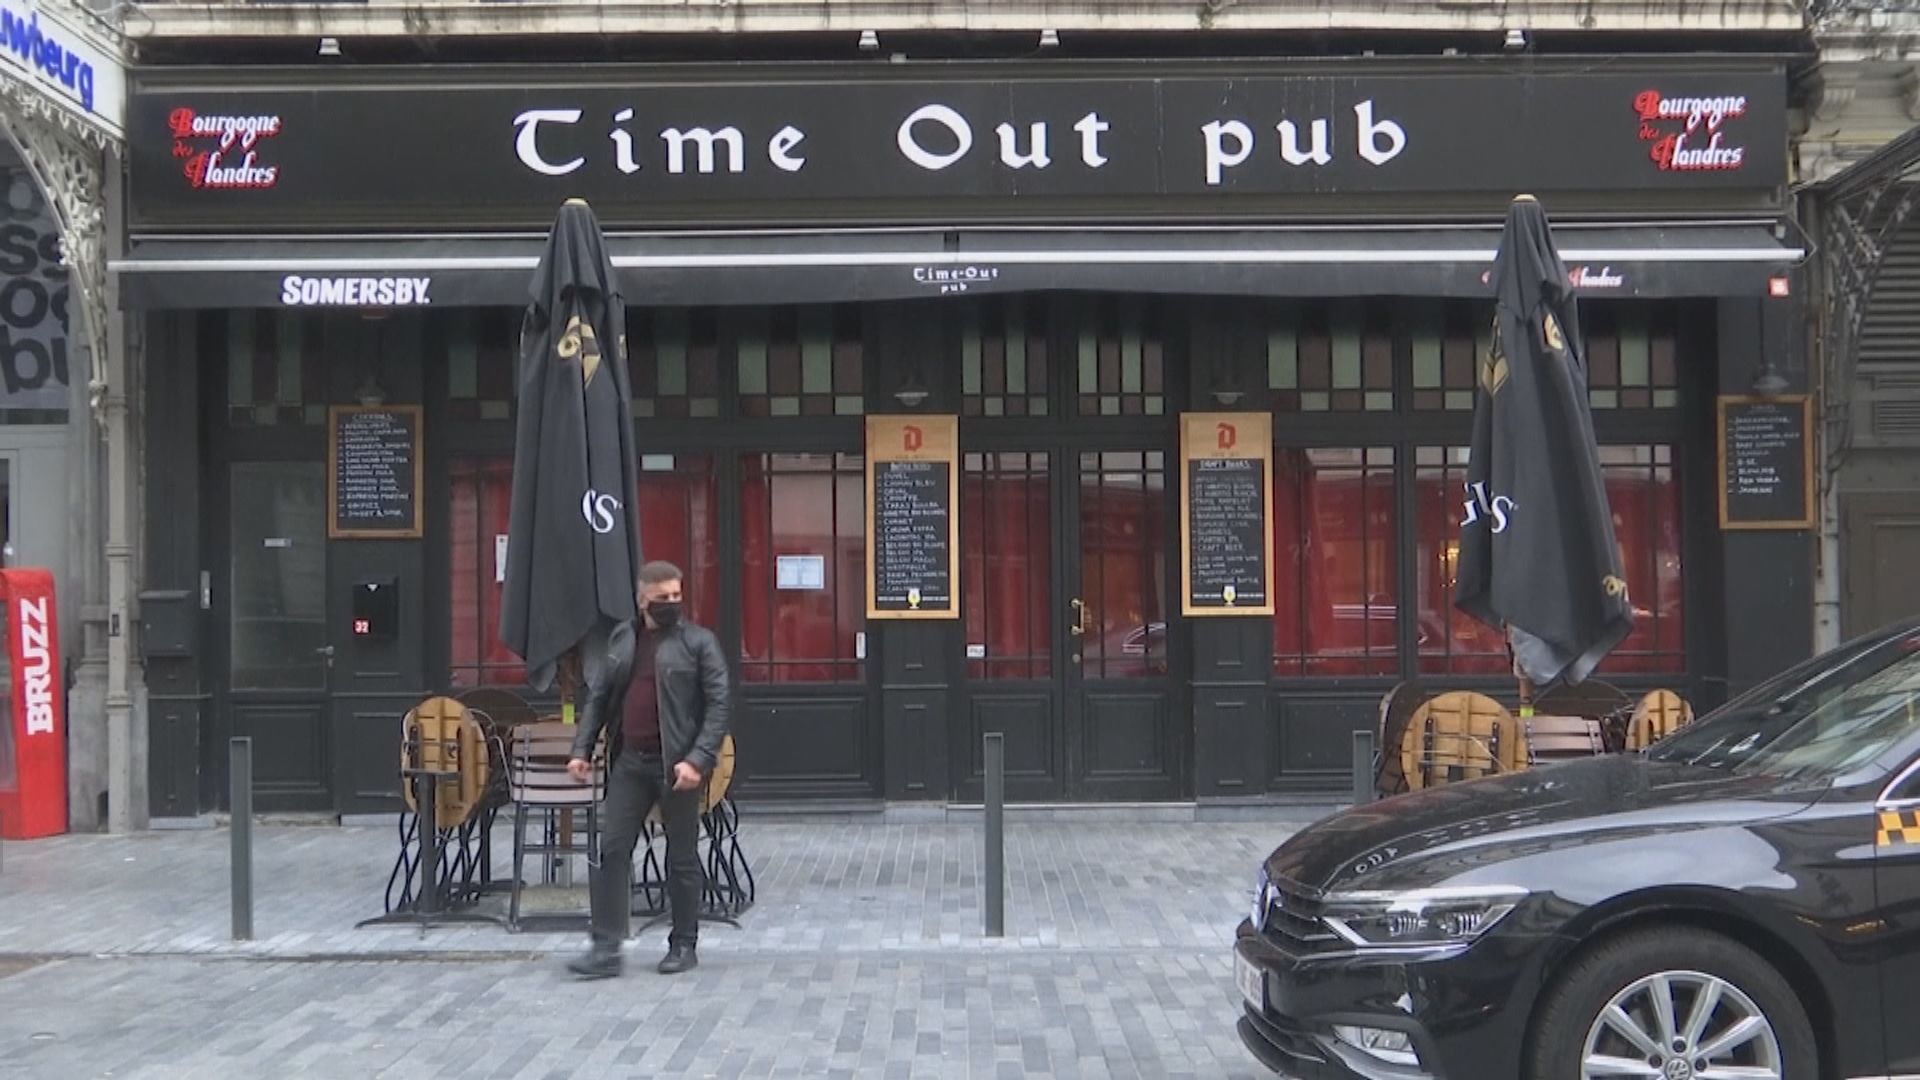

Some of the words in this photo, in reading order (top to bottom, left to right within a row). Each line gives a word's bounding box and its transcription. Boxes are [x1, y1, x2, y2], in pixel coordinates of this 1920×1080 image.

[168, 107, 281, 152] Bourgogne
[1632, 90, 1747, 135] Bourgogne
[513, 108, 805, 175] Time
[897, 104, 1109, 170] Out
[1201, 100, 1406, 184] pub
[1650, 132, 1745, 170] Flandres
[184, 151, 278, 189] Flandres
[941, 283, 968, 294] pub
[20, 597, 54, 736] BRUZZ
